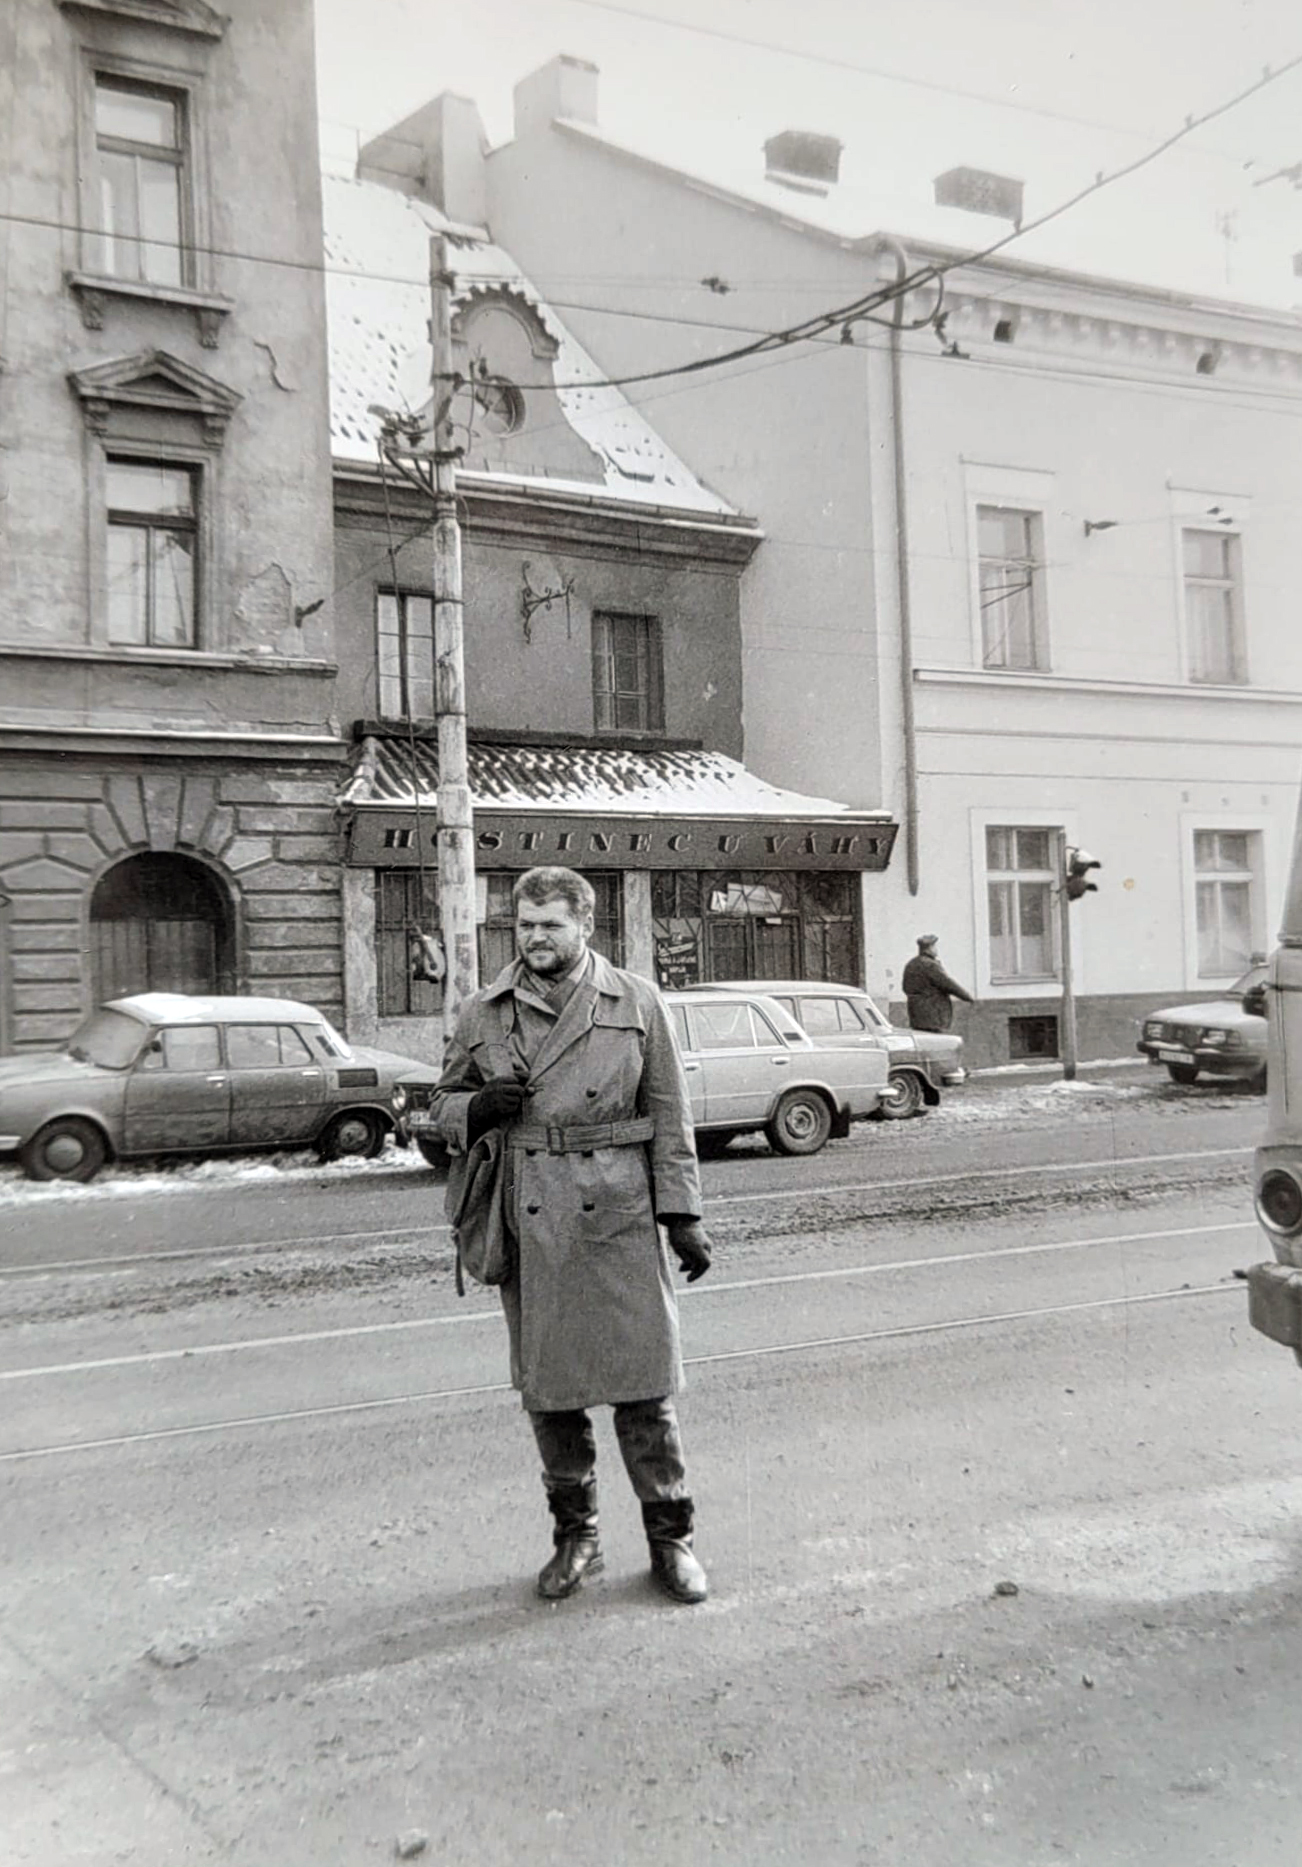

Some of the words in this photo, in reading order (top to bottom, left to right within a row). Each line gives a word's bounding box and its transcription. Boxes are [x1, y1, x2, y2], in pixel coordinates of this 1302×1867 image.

[383, 828, 691, 853] HSTINEC
[717, 833, 743, 854] U
[764, 831, 889, 855] VÁHY
